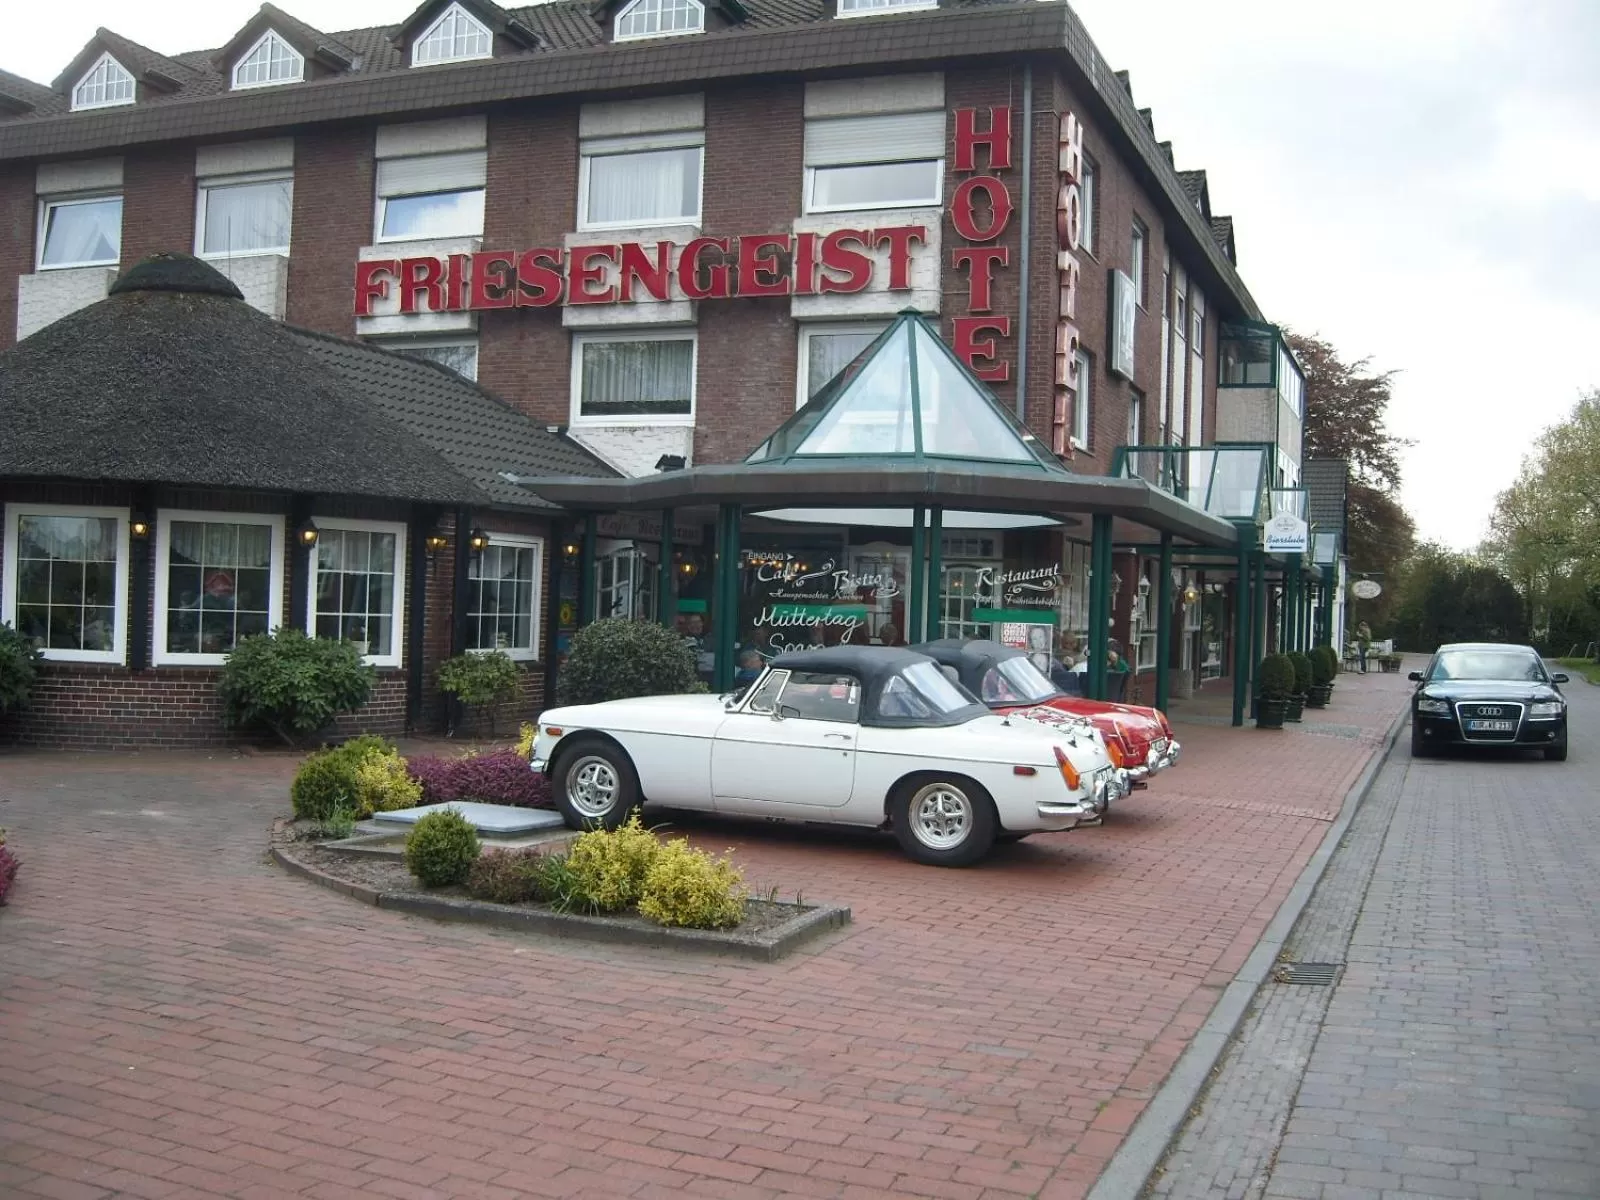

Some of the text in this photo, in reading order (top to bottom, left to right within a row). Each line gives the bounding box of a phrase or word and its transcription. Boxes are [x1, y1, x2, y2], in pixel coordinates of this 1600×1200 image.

[353, 225, 926, 317] FRIESENGEIST
[949, 105, 1015, 383] HOTE
[1053, 111, 1084, 462] HOTEL
[831, 569, 882, 592] Bistro
[975, 563, 1060, 589] Restaurant
